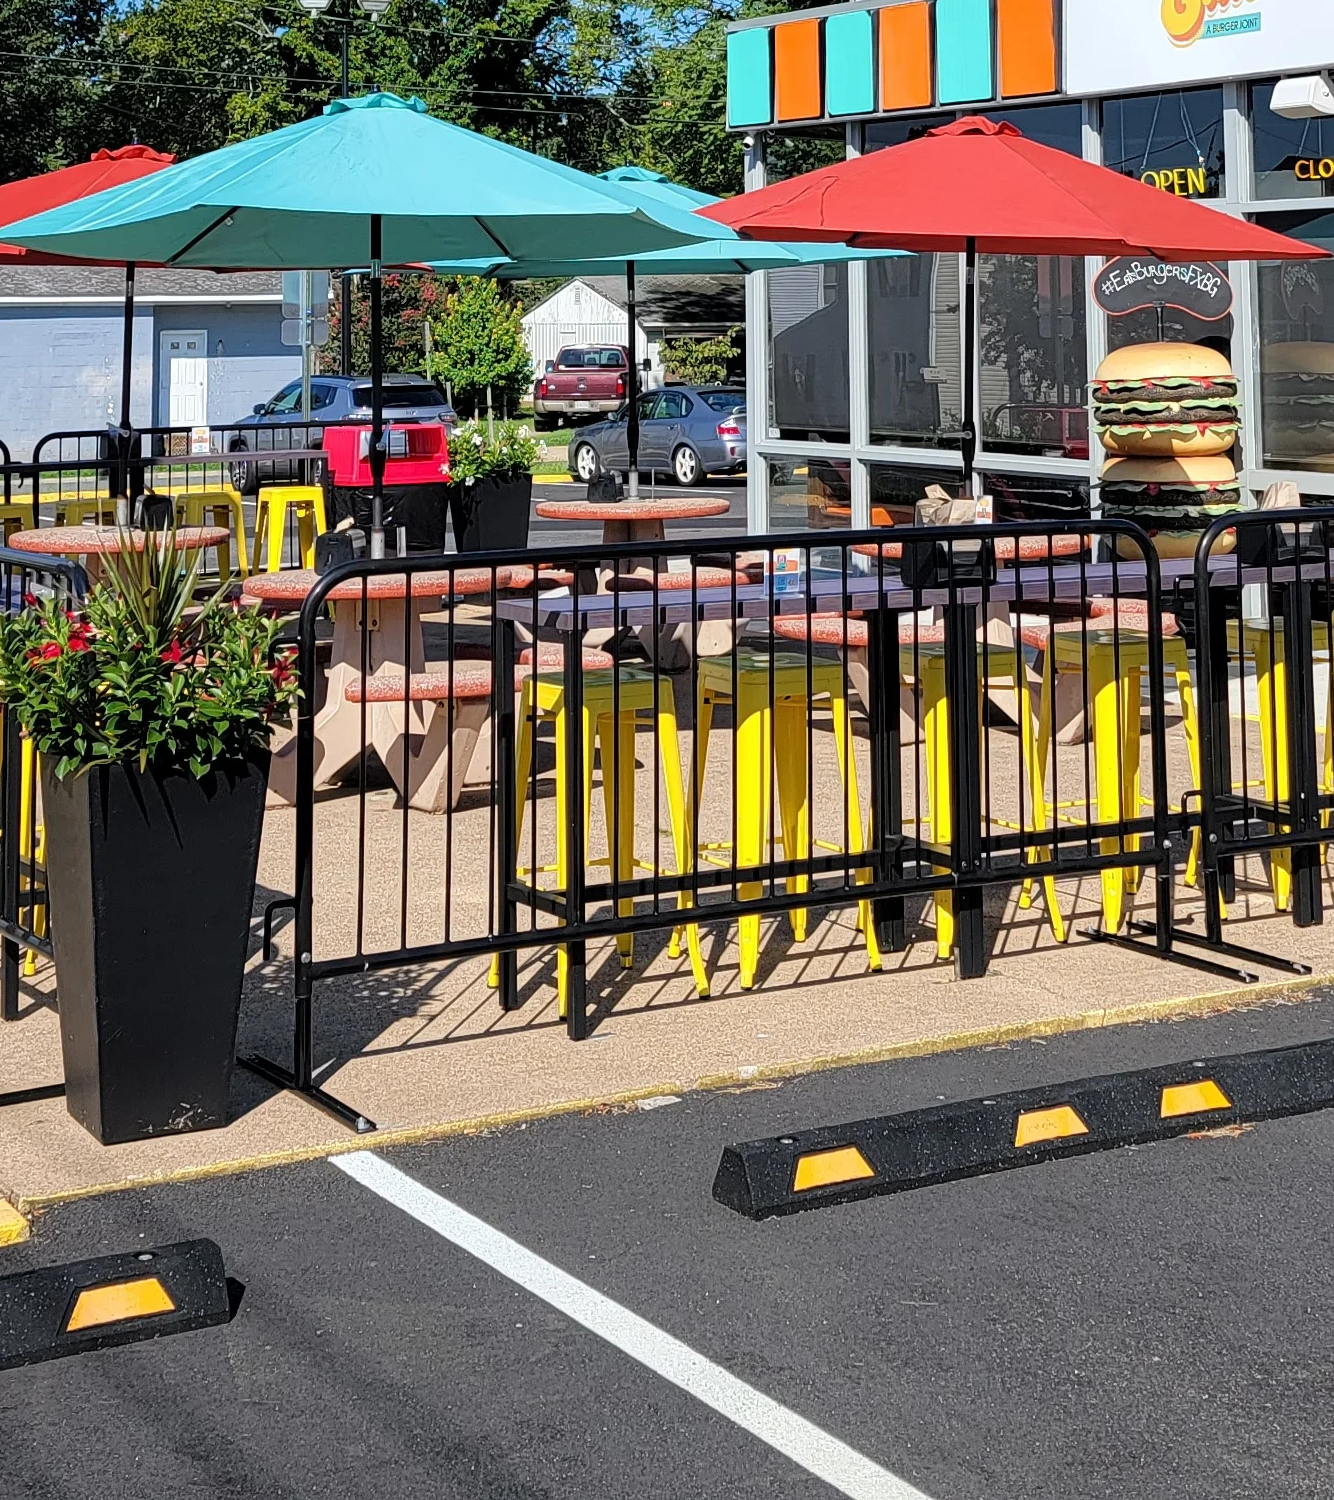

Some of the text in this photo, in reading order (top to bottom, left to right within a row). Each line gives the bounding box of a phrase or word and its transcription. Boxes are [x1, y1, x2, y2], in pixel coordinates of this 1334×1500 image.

[1212, 20, 1239, 34] BURGER
[1239, 17, 1259, 30] JOINT
[1140, 167, 1206, 196] OPEN
